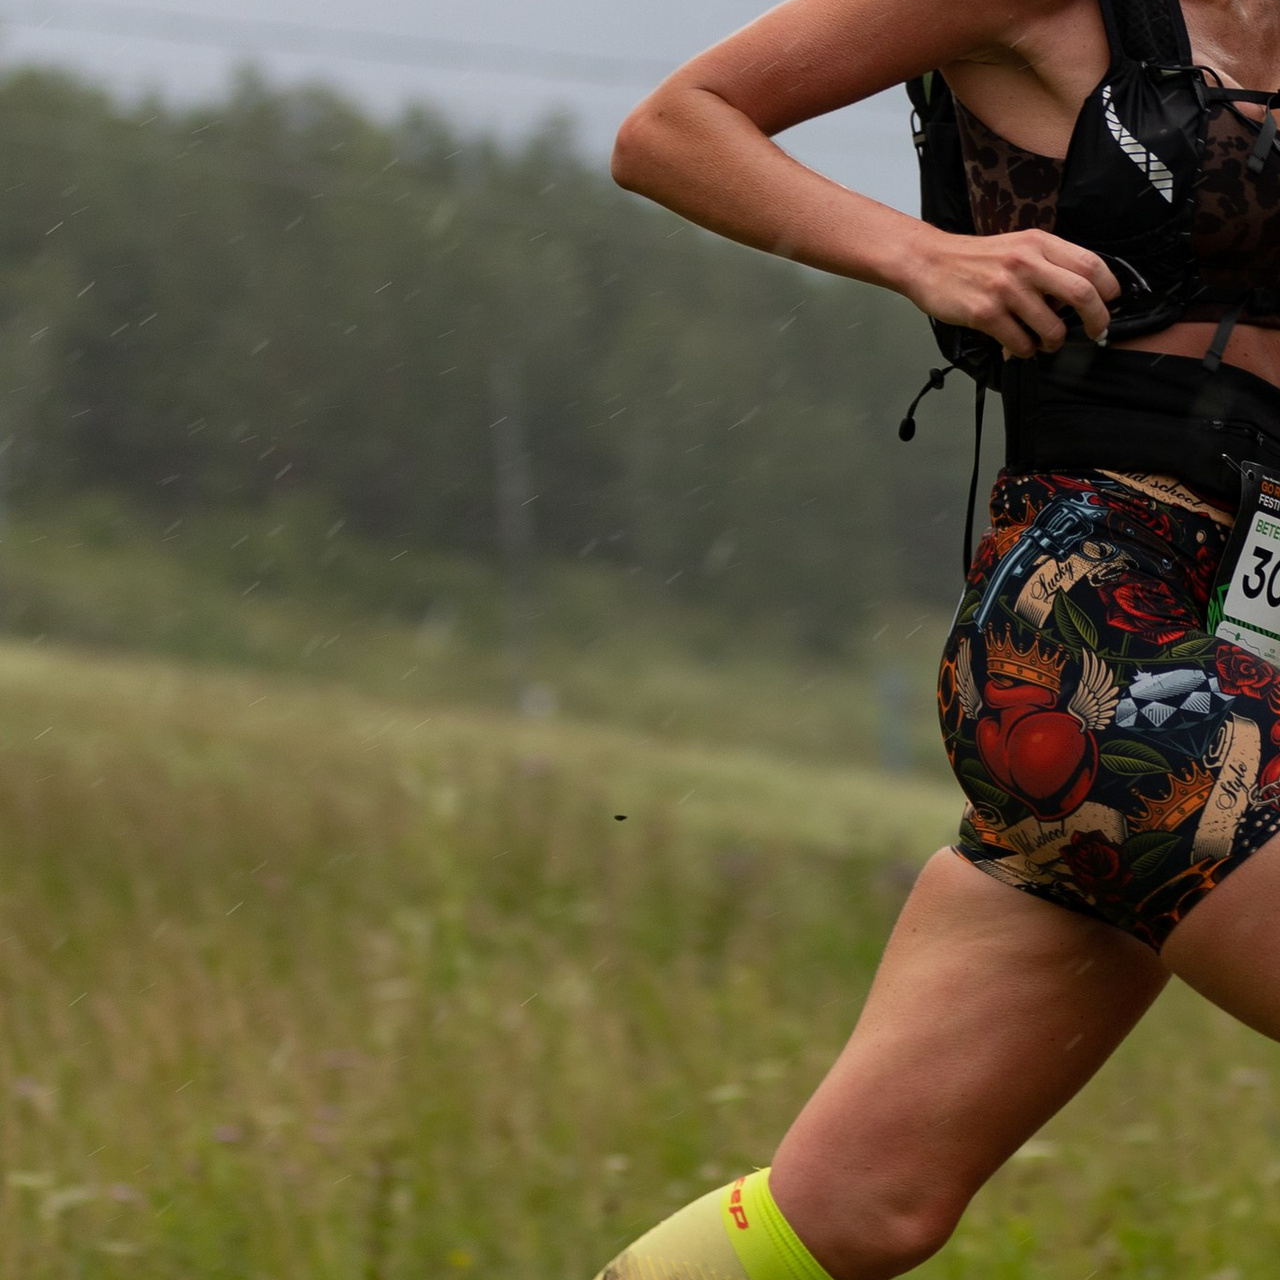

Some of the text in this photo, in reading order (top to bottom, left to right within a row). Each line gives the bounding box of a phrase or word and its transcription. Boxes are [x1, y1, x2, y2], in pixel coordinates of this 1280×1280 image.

[1150, 479, 1203, 507] school
[1261, 480, 1275, 494] GO
[1030, 560, 1073, 604] Lucky
[1216, 761, 1250, 810] Style
